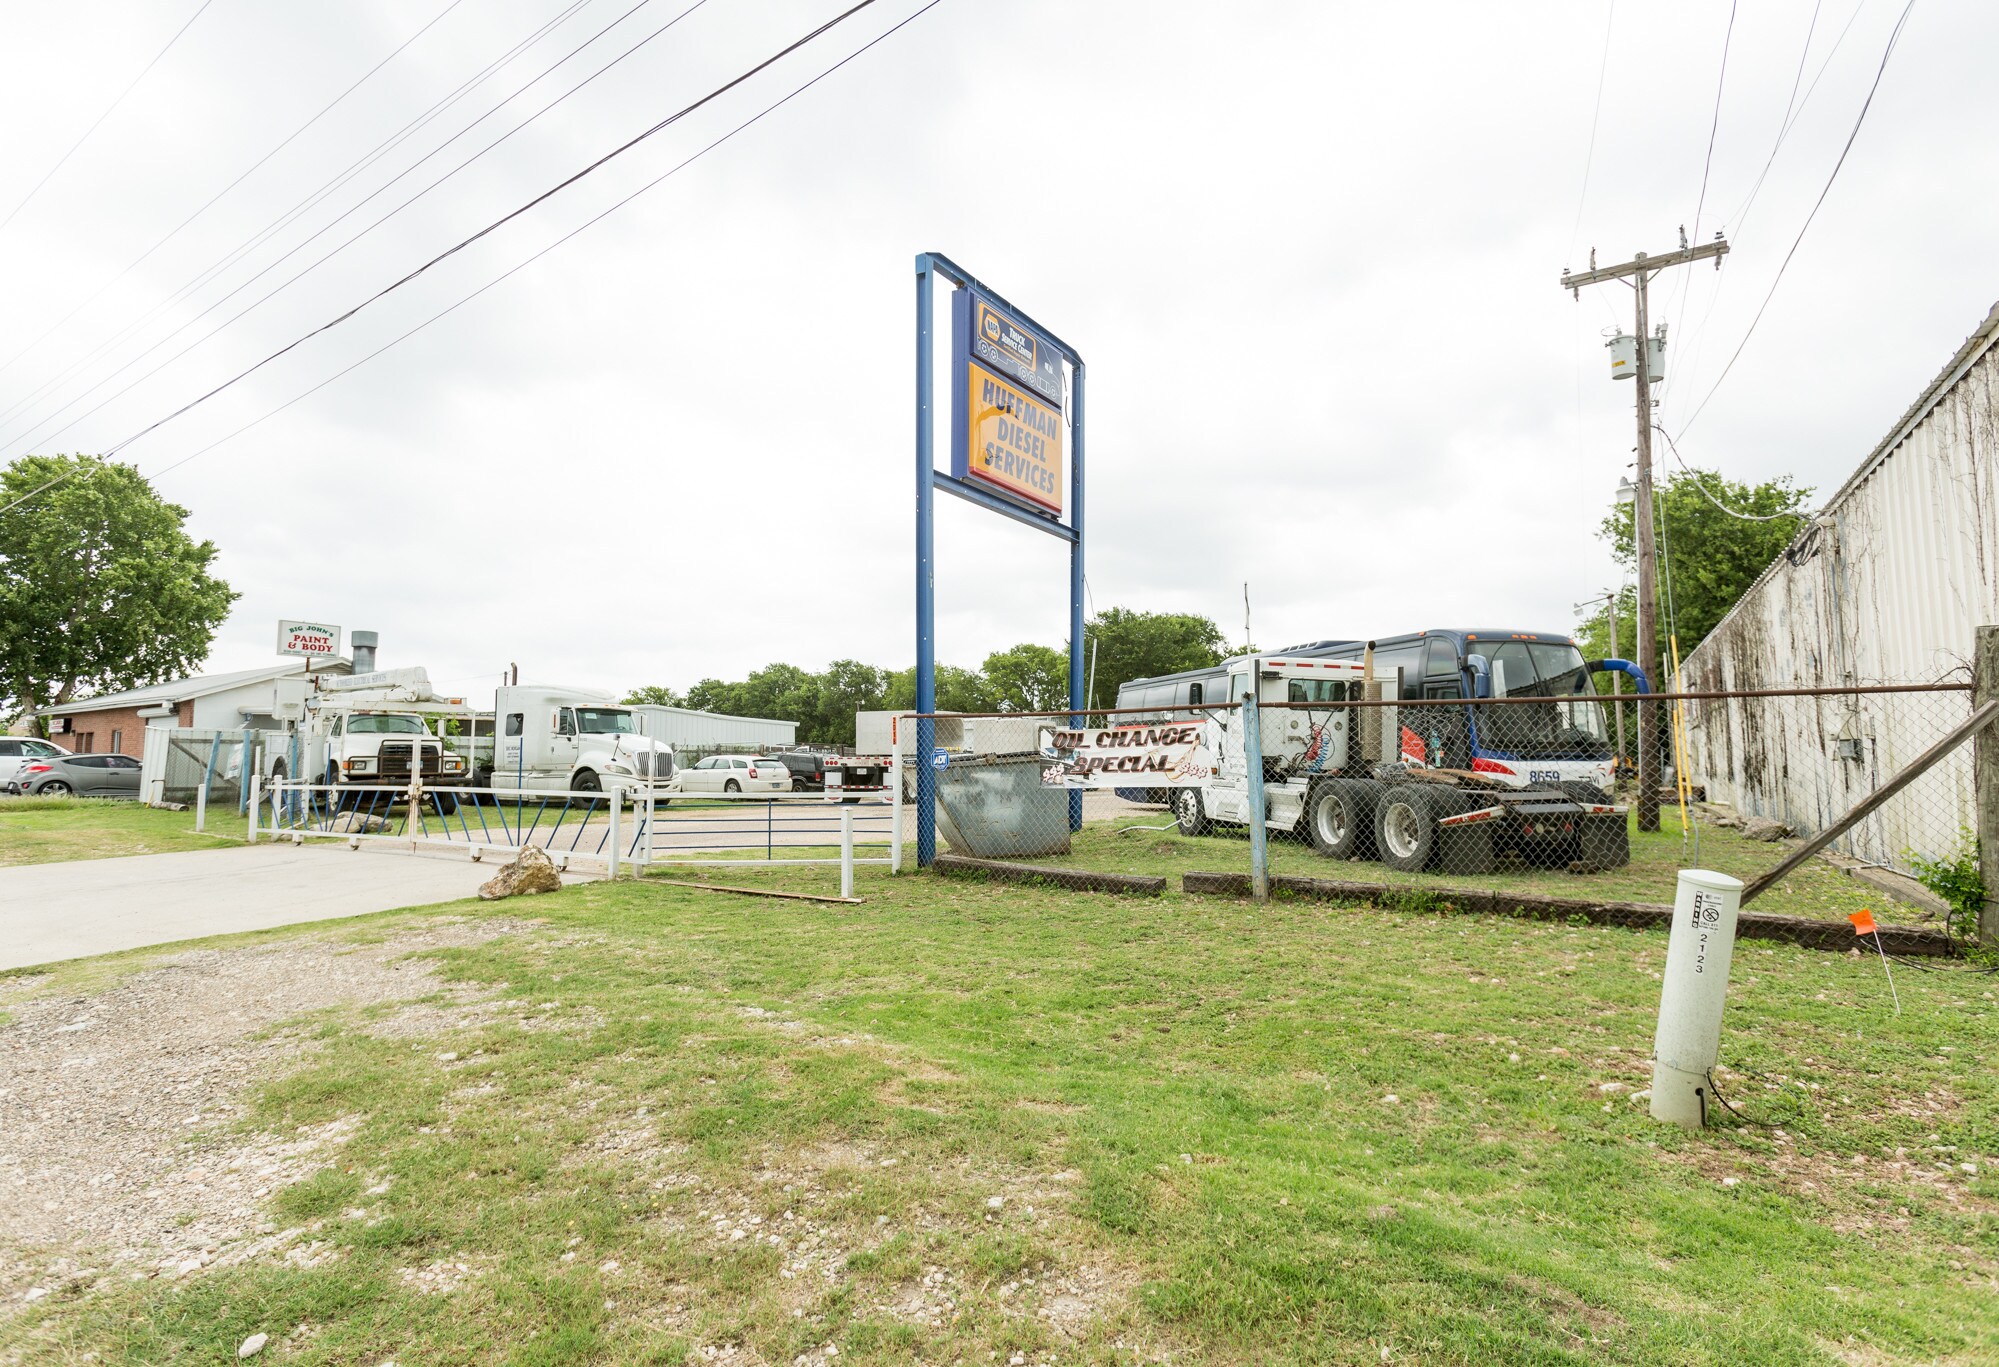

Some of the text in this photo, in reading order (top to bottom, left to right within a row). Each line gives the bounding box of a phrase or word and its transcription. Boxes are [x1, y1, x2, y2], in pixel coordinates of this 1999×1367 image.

[1001, 333, 1018, 351] SERVICE
[1018, 344, 1033, 361] CENTER
[1009, 327, 1026, 347] TRUCK
[983, 378, 1057, 440] HUFFMAN
[997, 416, 1046, 463] DIESEL
[985, 442, 1055, 494] SERVICES
[293, 635, 329, 644] PAINT
[306, 626, 334, 637] JOHN'S
[302, 643, 333, 652] BODY
[1051, 727, 1196, 749] OIL CHANGE
[933, 754, 947, 765] ADT
[1069, 755, 1176, 775] SPECIAL
[1529, 770, 1560, 784] 8659
[1692, 890, 1703, 928] WARNING
